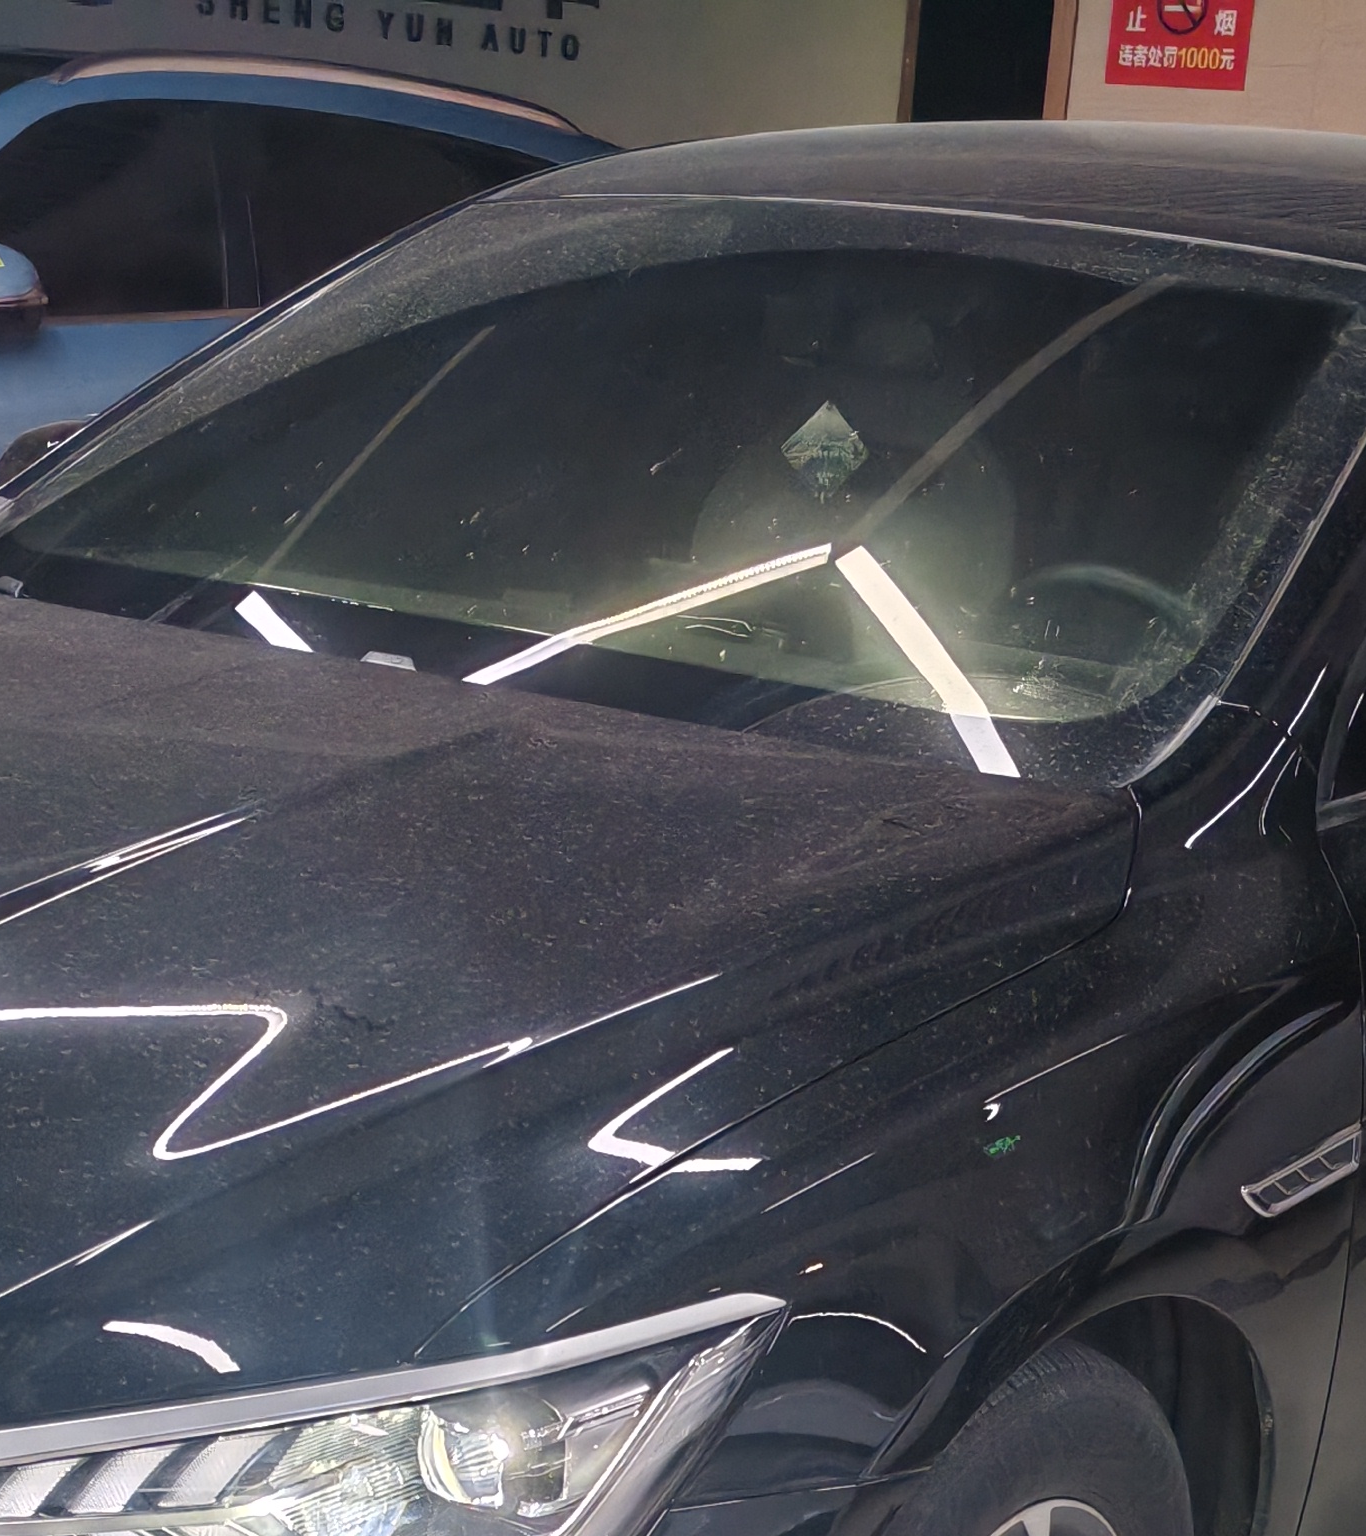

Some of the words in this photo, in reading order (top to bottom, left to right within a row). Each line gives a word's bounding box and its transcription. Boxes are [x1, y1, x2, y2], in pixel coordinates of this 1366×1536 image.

[1126, 6, 1147, 32] 止
[1214, 9, 1238, 36] 烟
[481, 24, 580, 61] AUTO
[1118, 44, 1236, 70] 违者处罚1000元
